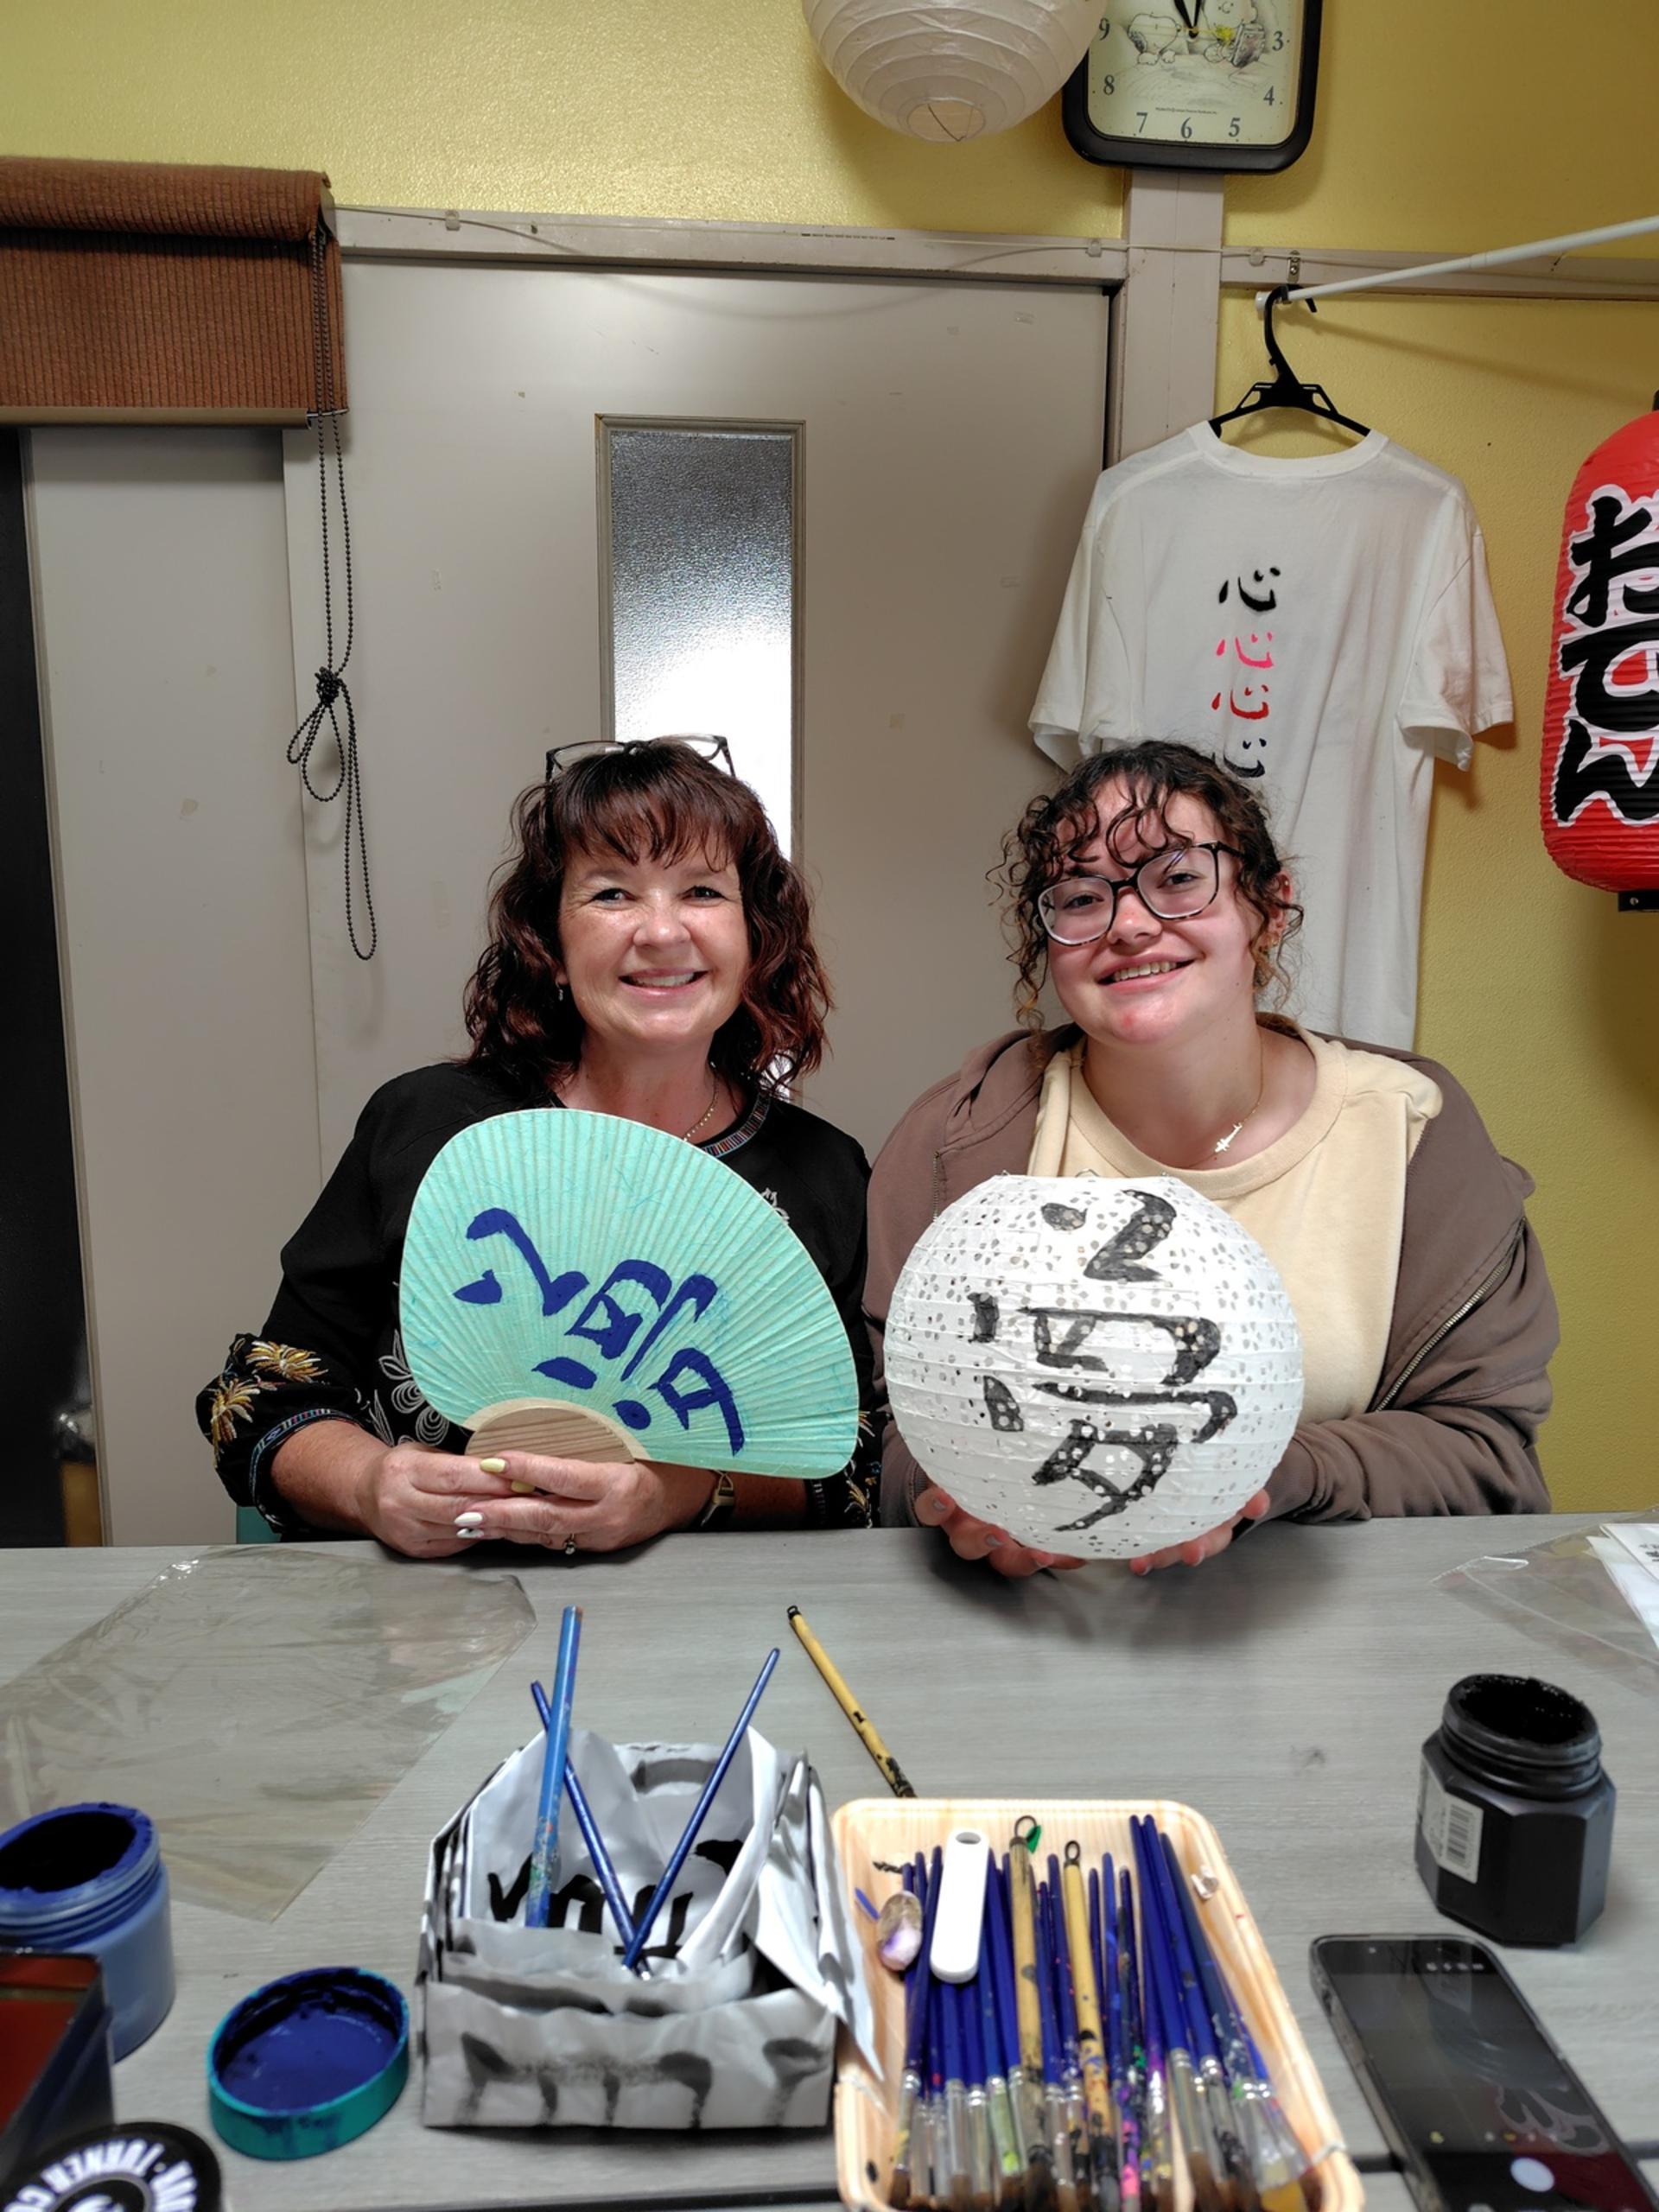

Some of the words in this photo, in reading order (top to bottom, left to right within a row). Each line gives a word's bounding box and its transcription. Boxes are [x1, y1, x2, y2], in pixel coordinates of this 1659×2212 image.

[1098, 18, 1110, 41] 9
[1272, 31, 1283, 51] 3
[1103, 74, 1115, 95] 8
[1263, 86, 1274, 105] 4
[1136, 112, 1147, 133] 7
[1180, 118, 1192, 138] 6
[1229, 118, 1241, 137] 5
